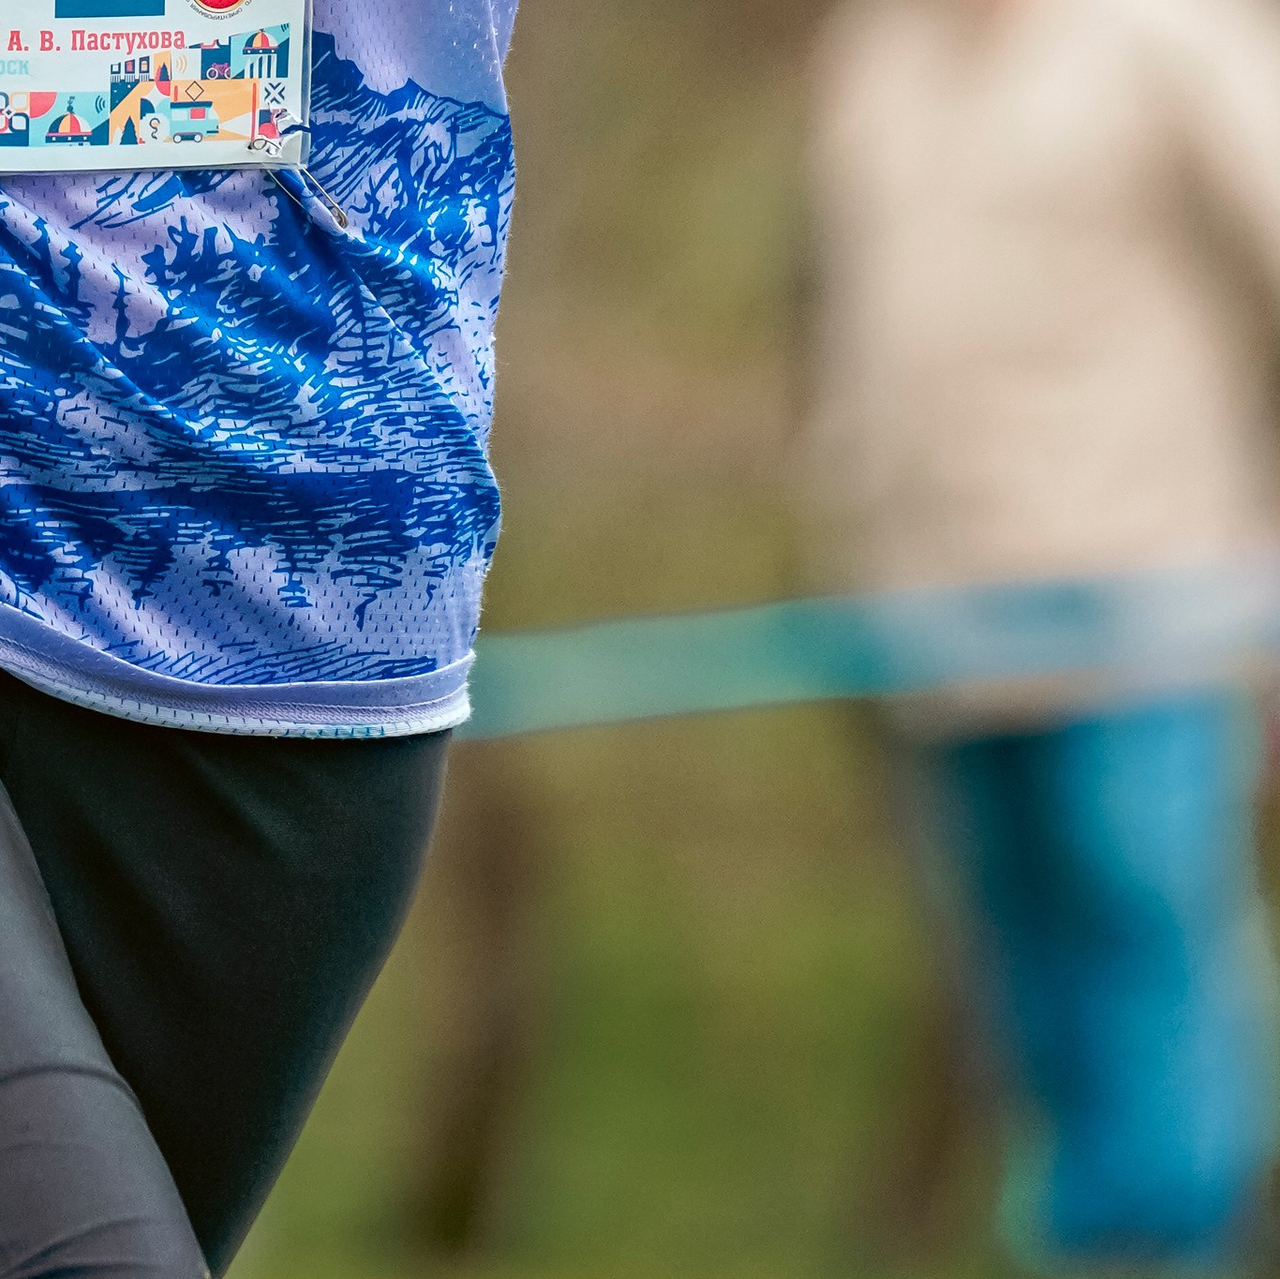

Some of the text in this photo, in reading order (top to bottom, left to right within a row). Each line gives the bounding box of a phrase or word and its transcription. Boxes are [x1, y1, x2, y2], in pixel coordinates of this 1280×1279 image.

[7, 30, 29, 51] А.
[40, 30, 61, 51] В.
[71, 29, 186, 55] Пастухова
